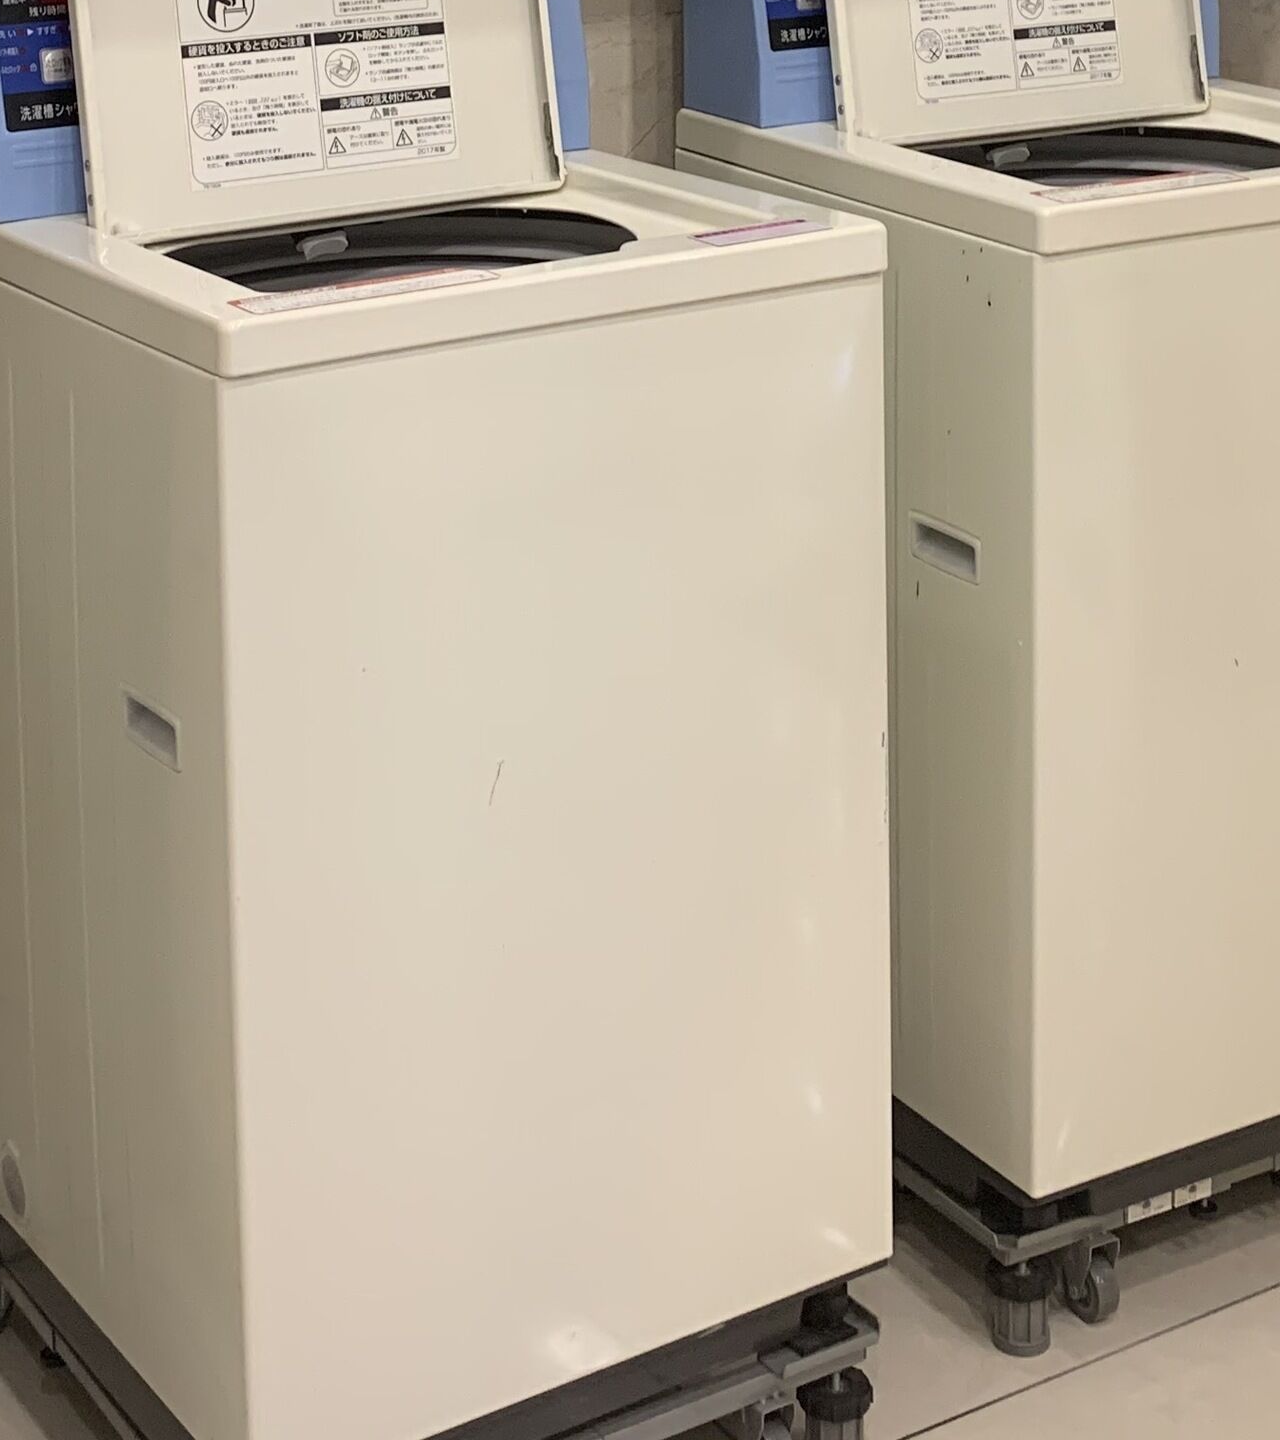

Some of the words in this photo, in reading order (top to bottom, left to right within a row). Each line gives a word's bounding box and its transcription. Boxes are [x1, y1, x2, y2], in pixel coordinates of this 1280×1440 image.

[337, 26, 420, 43] ソフト剤のご使用方法
[187, 36, 306, 58] 硬貨を投入するときのご注意
[339, 88, 437, 109] 洗濯機の据え付けについて
[382, 107, 399, 117] 警告
